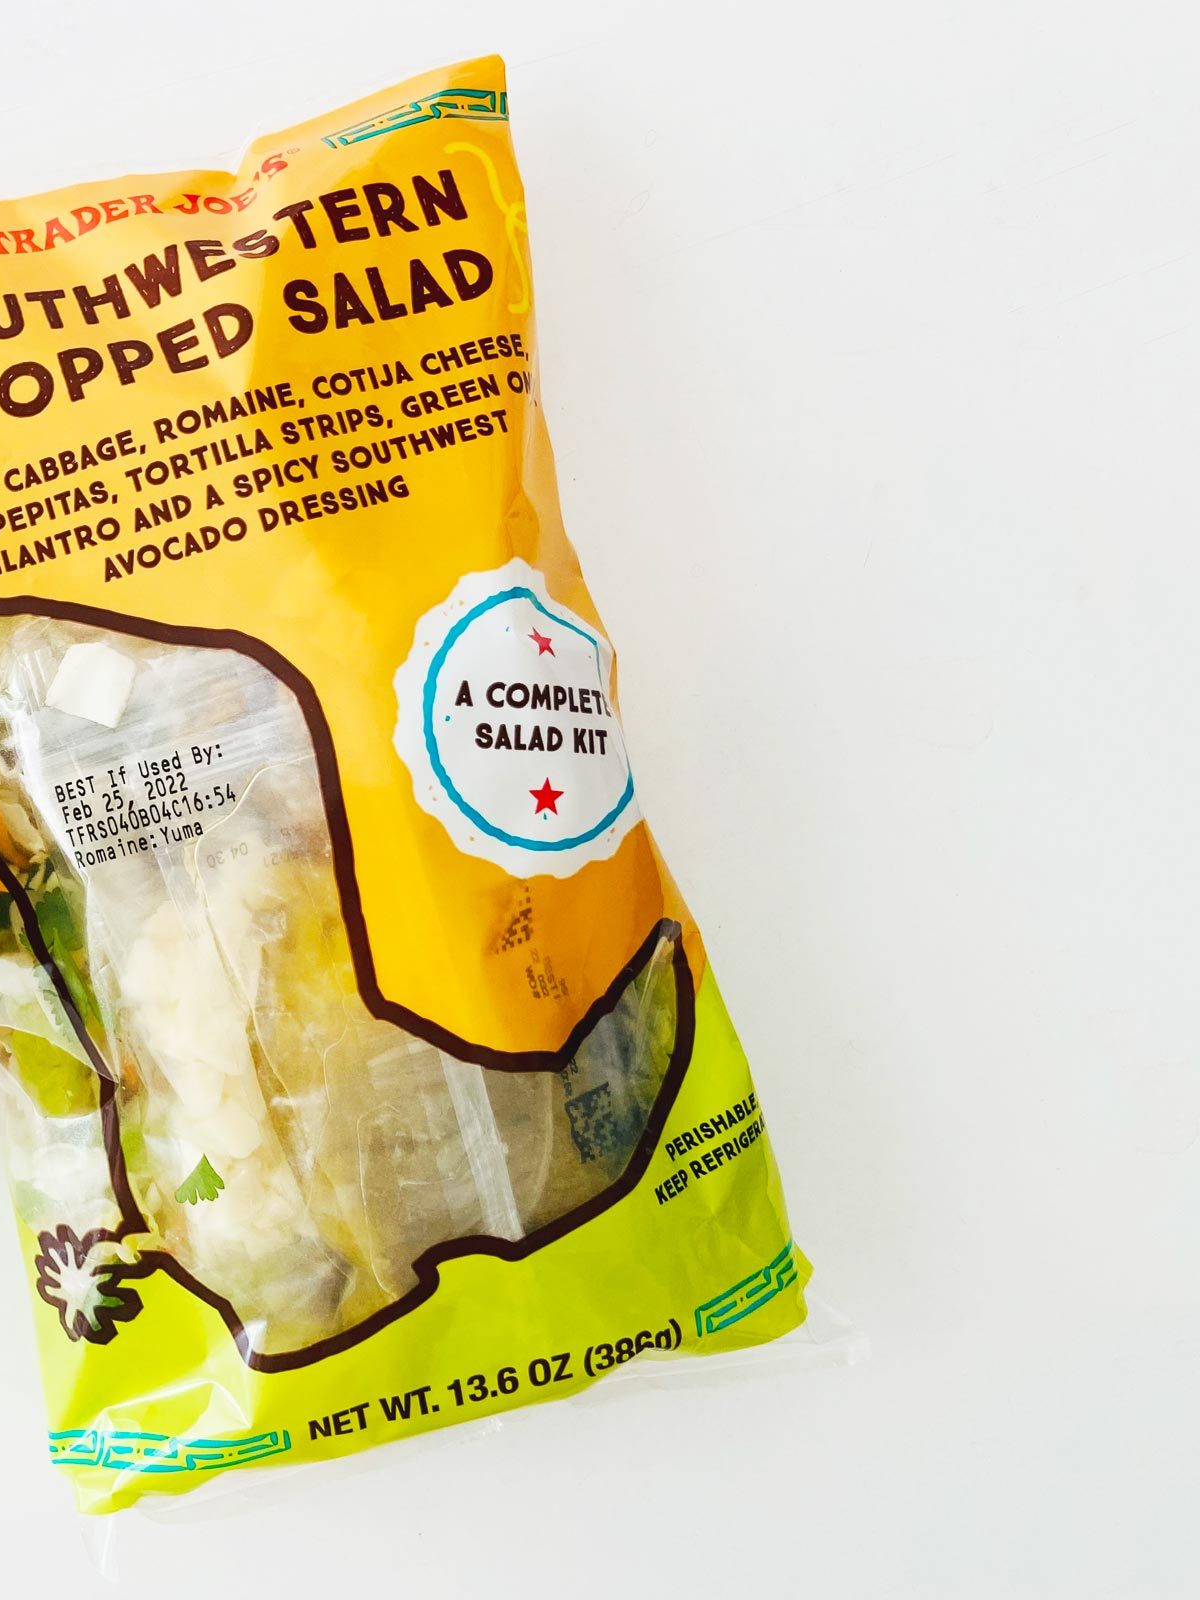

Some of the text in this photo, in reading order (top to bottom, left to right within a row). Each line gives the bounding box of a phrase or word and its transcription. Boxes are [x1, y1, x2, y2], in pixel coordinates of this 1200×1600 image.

[173, 152, 288, 215] JOE'S
[283, 249, 493, 334] SALAD
[4, 430, 146, 492] CABBAGE,
[154, 382, 305, 444] ROMAINE,
[312, 361, 414, 399] COTIJA
[420, 333, 529, 376] CHEESE,
[125, 428, 273, 492] TORTILLA
[281, 404, 393, 445] STRIPS,
[401, 374, 500, 418] GREEN
[135, 495, 191, 533] AND
[207, 484, 224, 510] A
[233, 454, 318, 498] SPICY
[331, 409, 508, 473] SOUTHWEST
[105, 475, 410, 582] AVOCADO DRESSING
[455, 680, 474, 707] A
[54, 743, 223, 804] BEST If Used By:
[475, 722, 608, 756] SALAD KIT
[61, 771, 189, 825] Feb 25, 2022
[654, 1169, 689, 1206] KEEP
[308, 1401, 370, 1441] NET
[378, 1385, 440, 1422] WT.
[446, 1366, 520, 1407] 13.6
[528, 1352, 574, 1387] OZ
